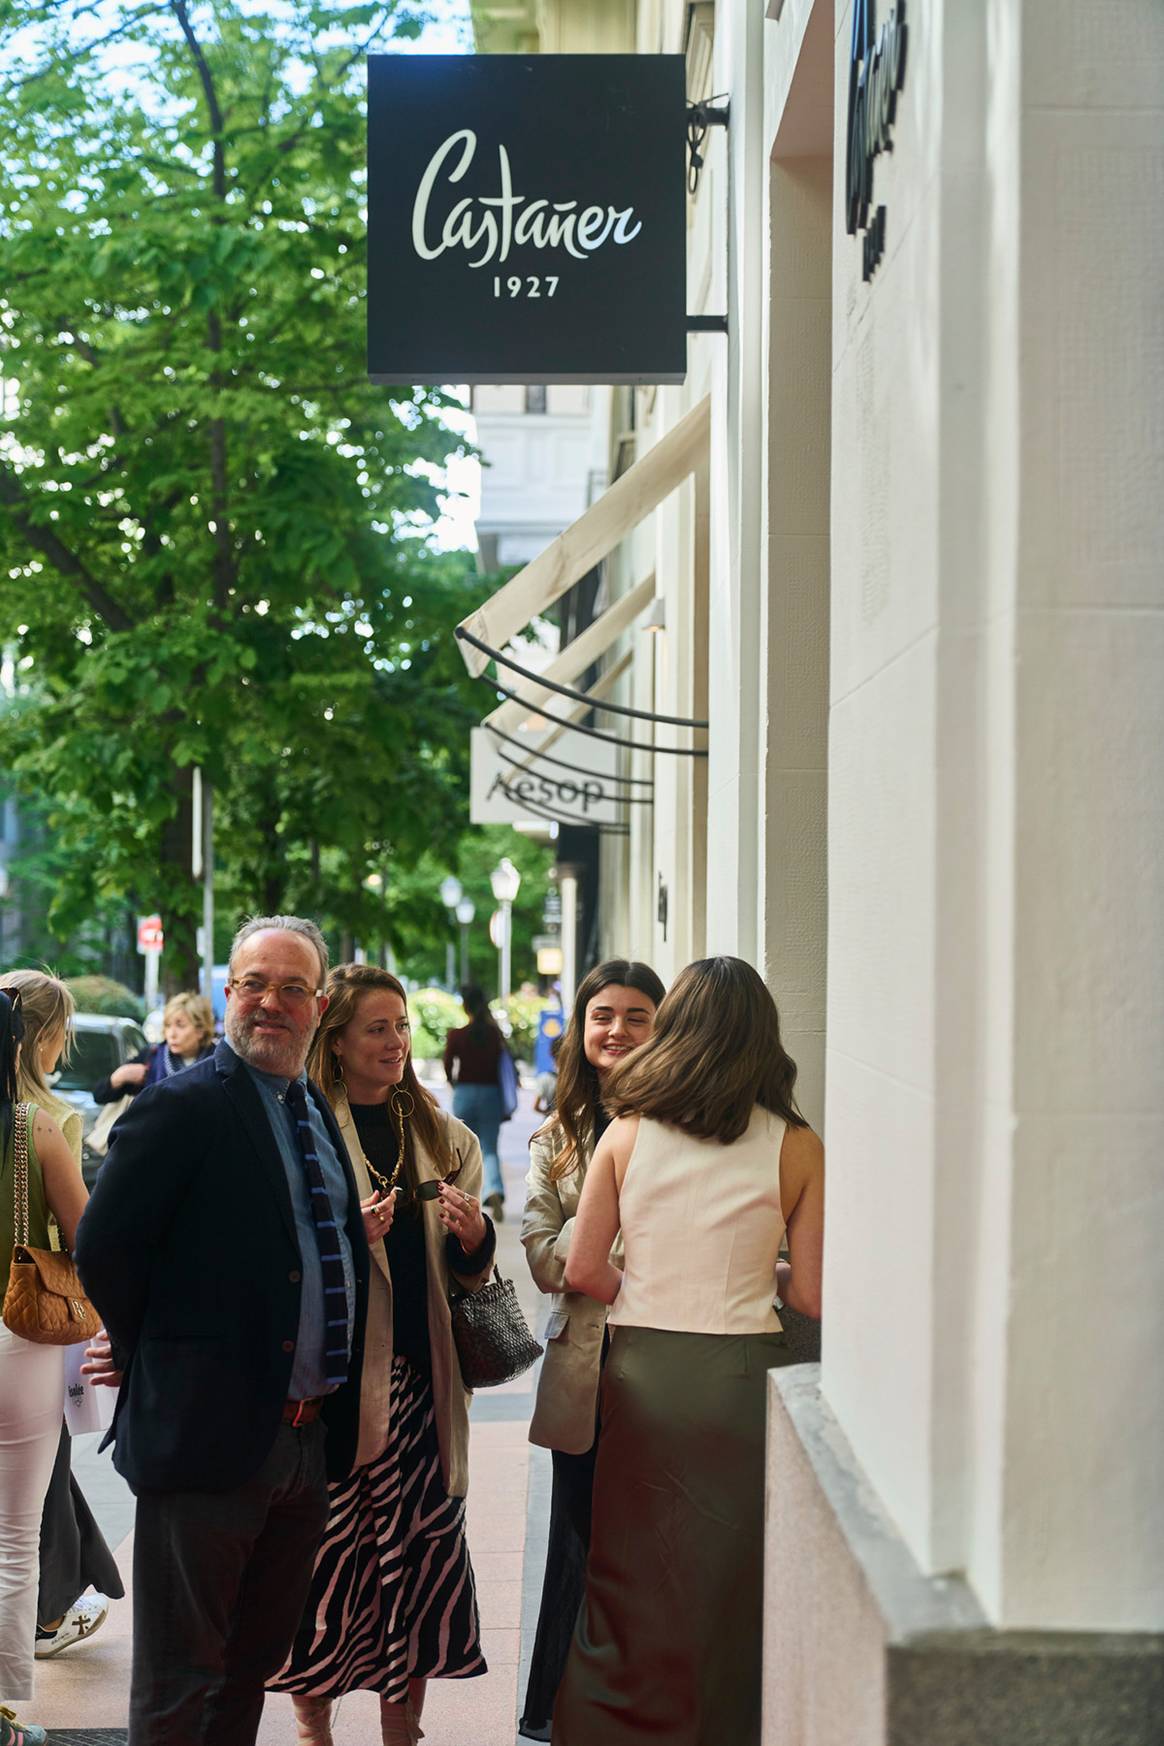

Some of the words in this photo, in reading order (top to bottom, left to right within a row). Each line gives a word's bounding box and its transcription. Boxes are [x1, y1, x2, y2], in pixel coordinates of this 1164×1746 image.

[412, 129, 642, 268] Castañer
[494, 276, 559, 298] 1927
[486, 773, 604, 812] Aesop
